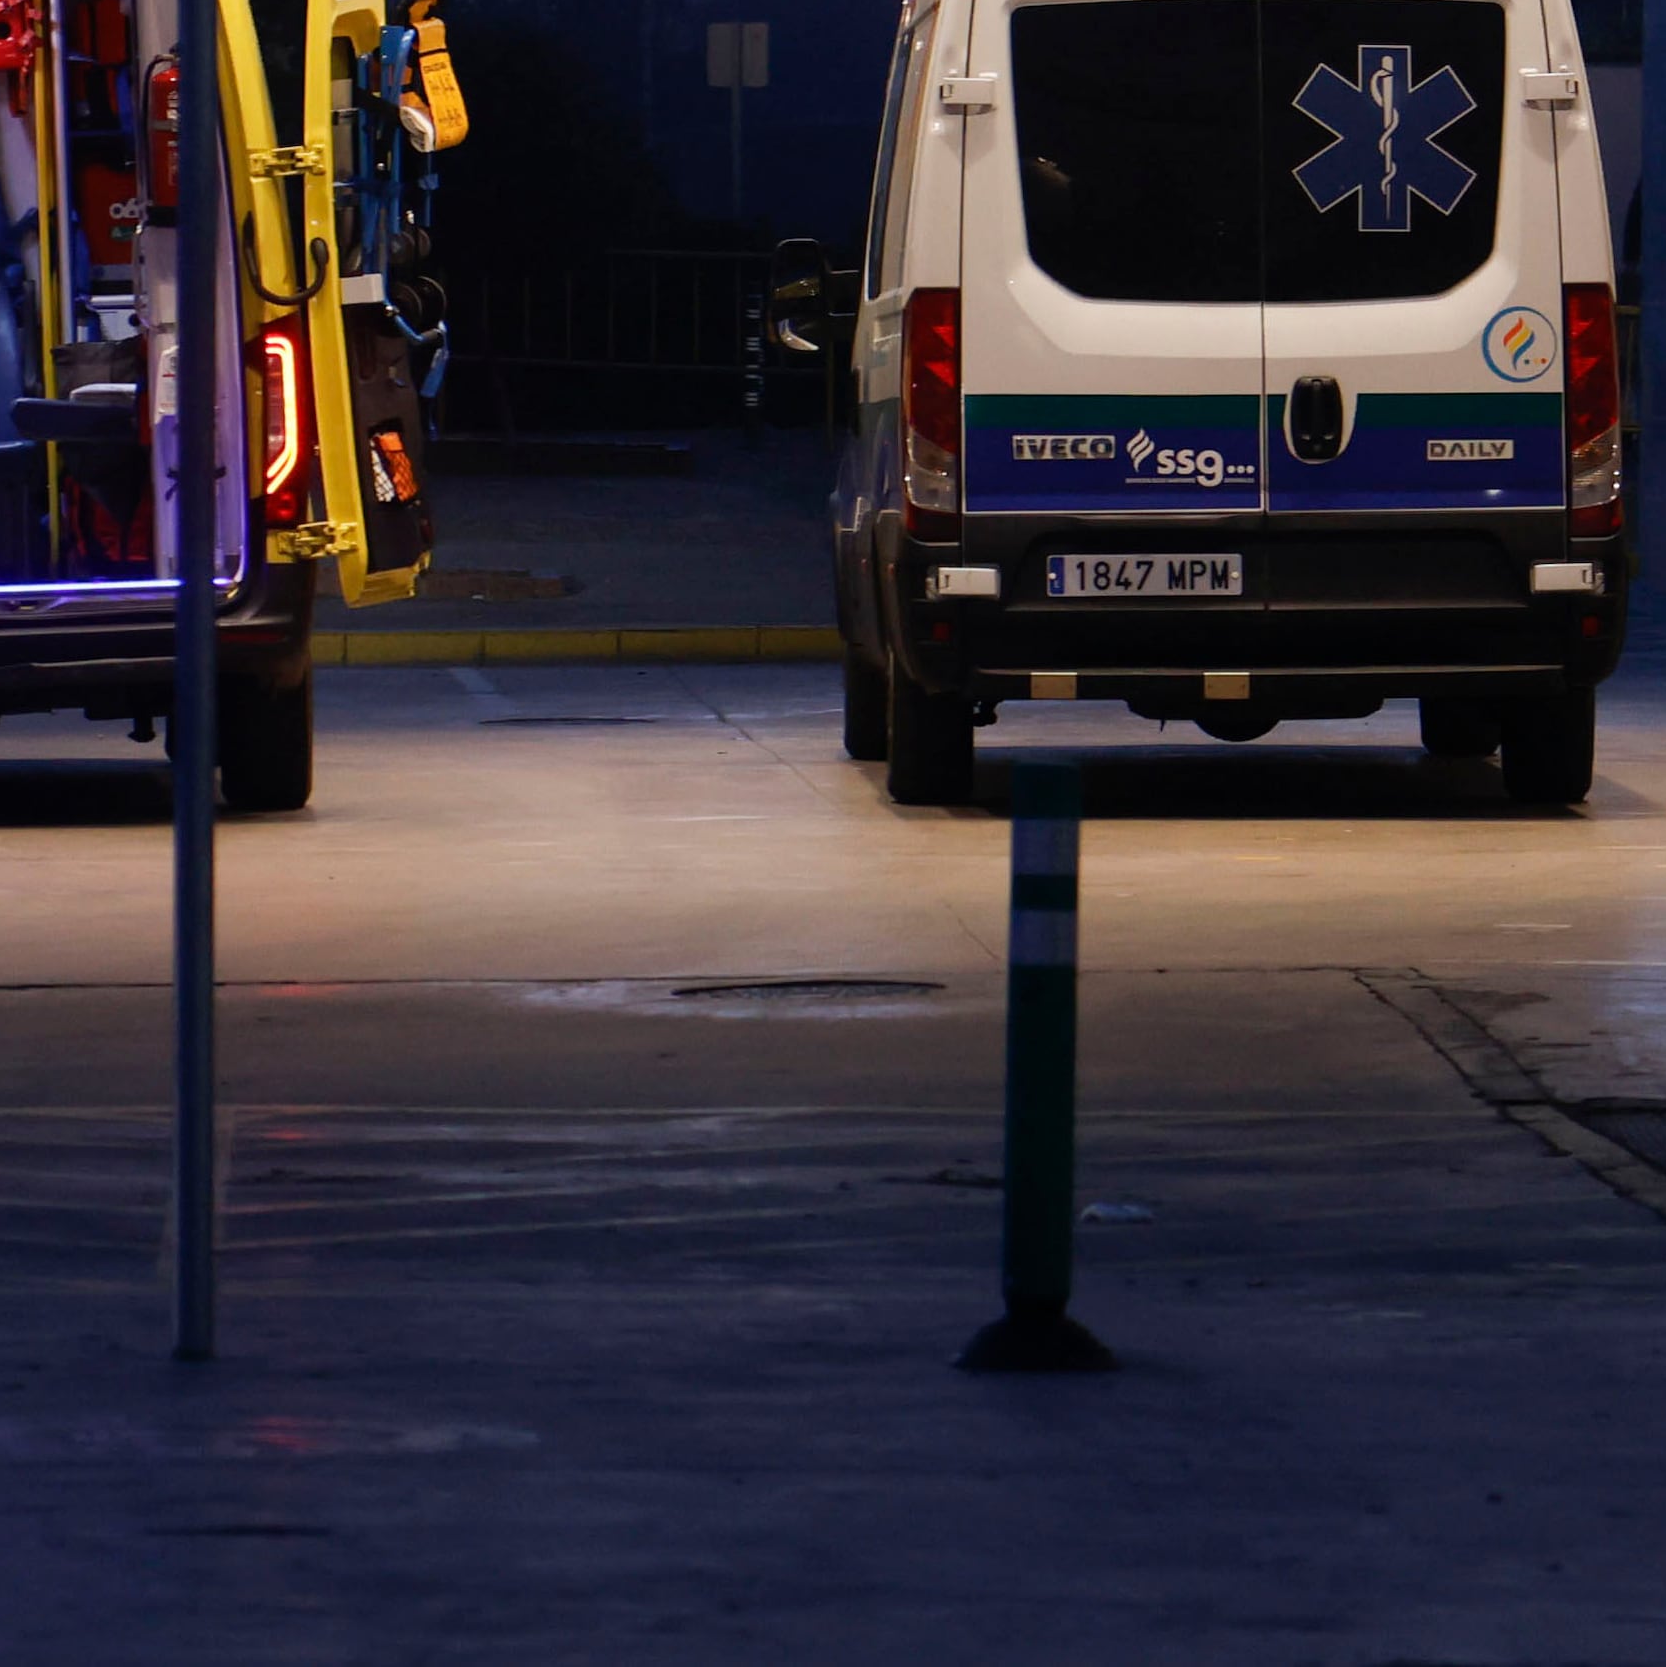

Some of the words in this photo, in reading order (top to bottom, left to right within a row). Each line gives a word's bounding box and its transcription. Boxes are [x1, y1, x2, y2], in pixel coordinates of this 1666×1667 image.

[1014, 437, 1114, 459] IVECO
[1430, 441, 1508, 458] DAILY
[1075, 561, 1155, 592] 1847
[1169, 561, 1229, 591] MPM
